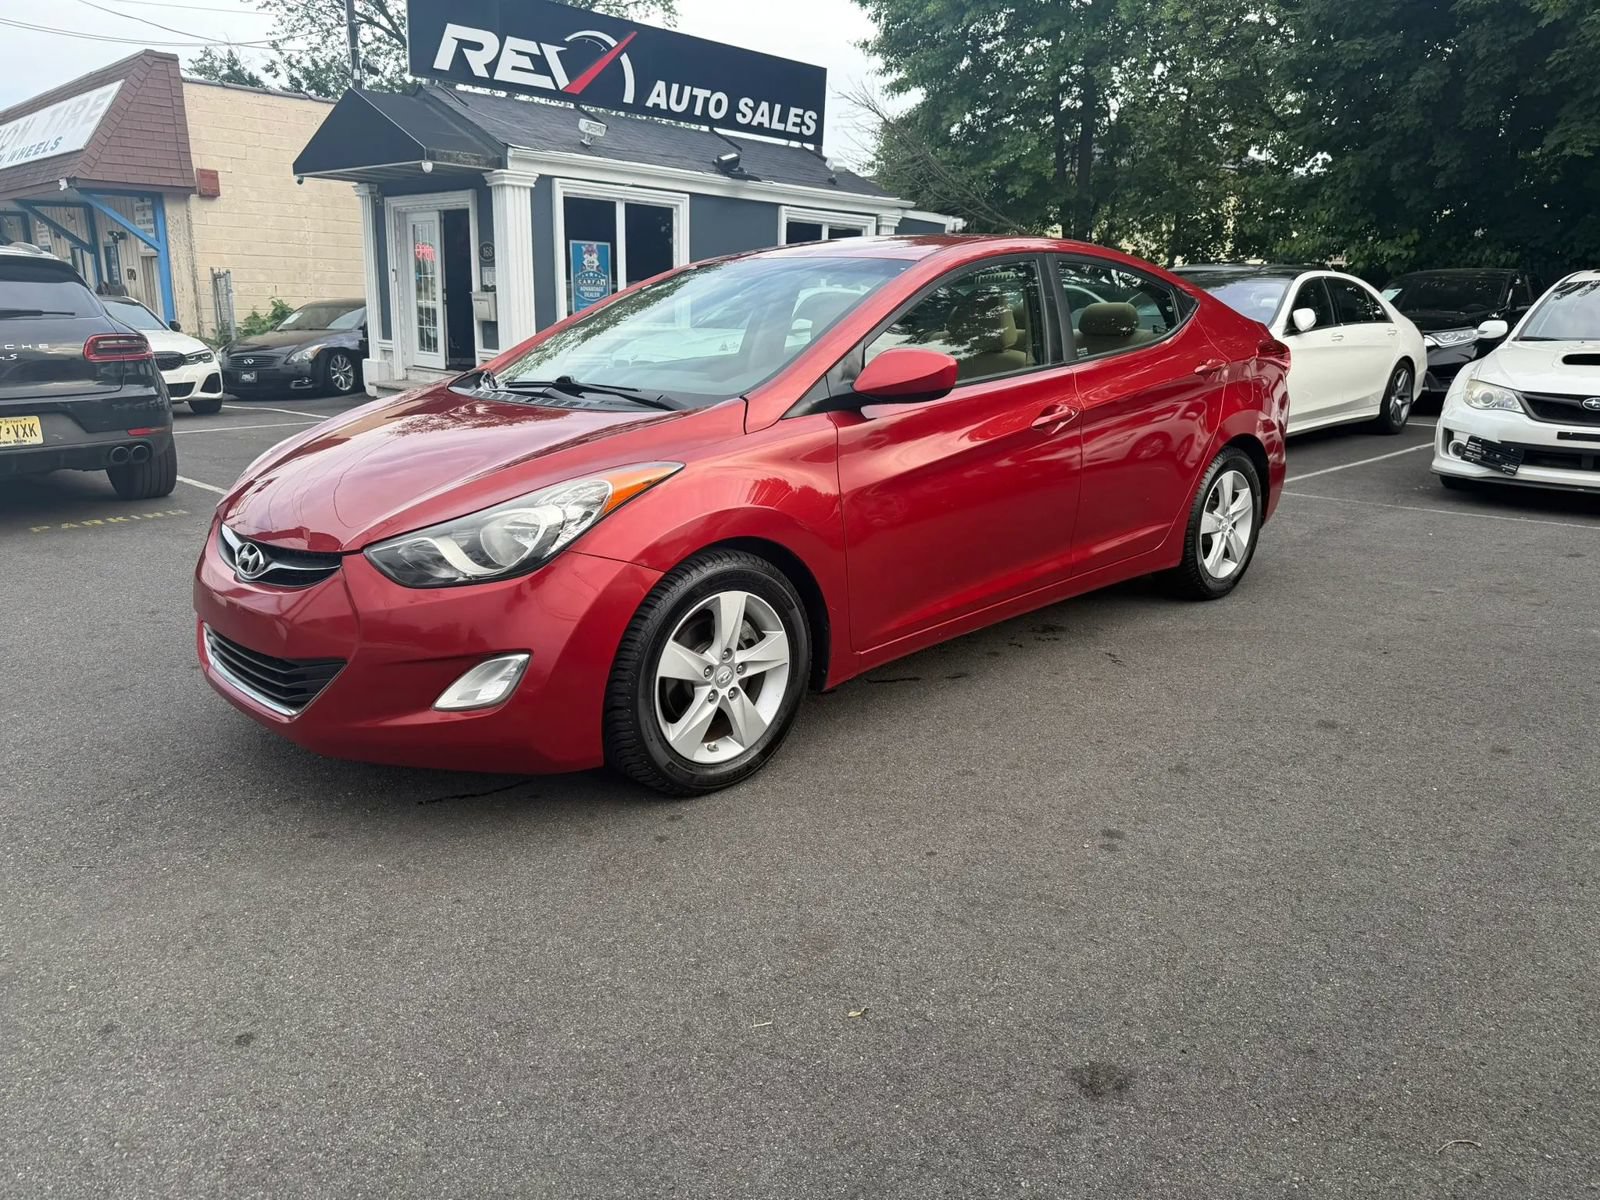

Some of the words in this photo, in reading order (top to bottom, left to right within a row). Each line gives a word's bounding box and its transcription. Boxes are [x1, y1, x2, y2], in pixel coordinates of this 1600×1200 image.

[645, 80, 729, 120] AUTO
[735, 97, 818, 137] SALES
[7, 136, 63, 163] WHEELS
[30, 509, 190, 532] PARKING
